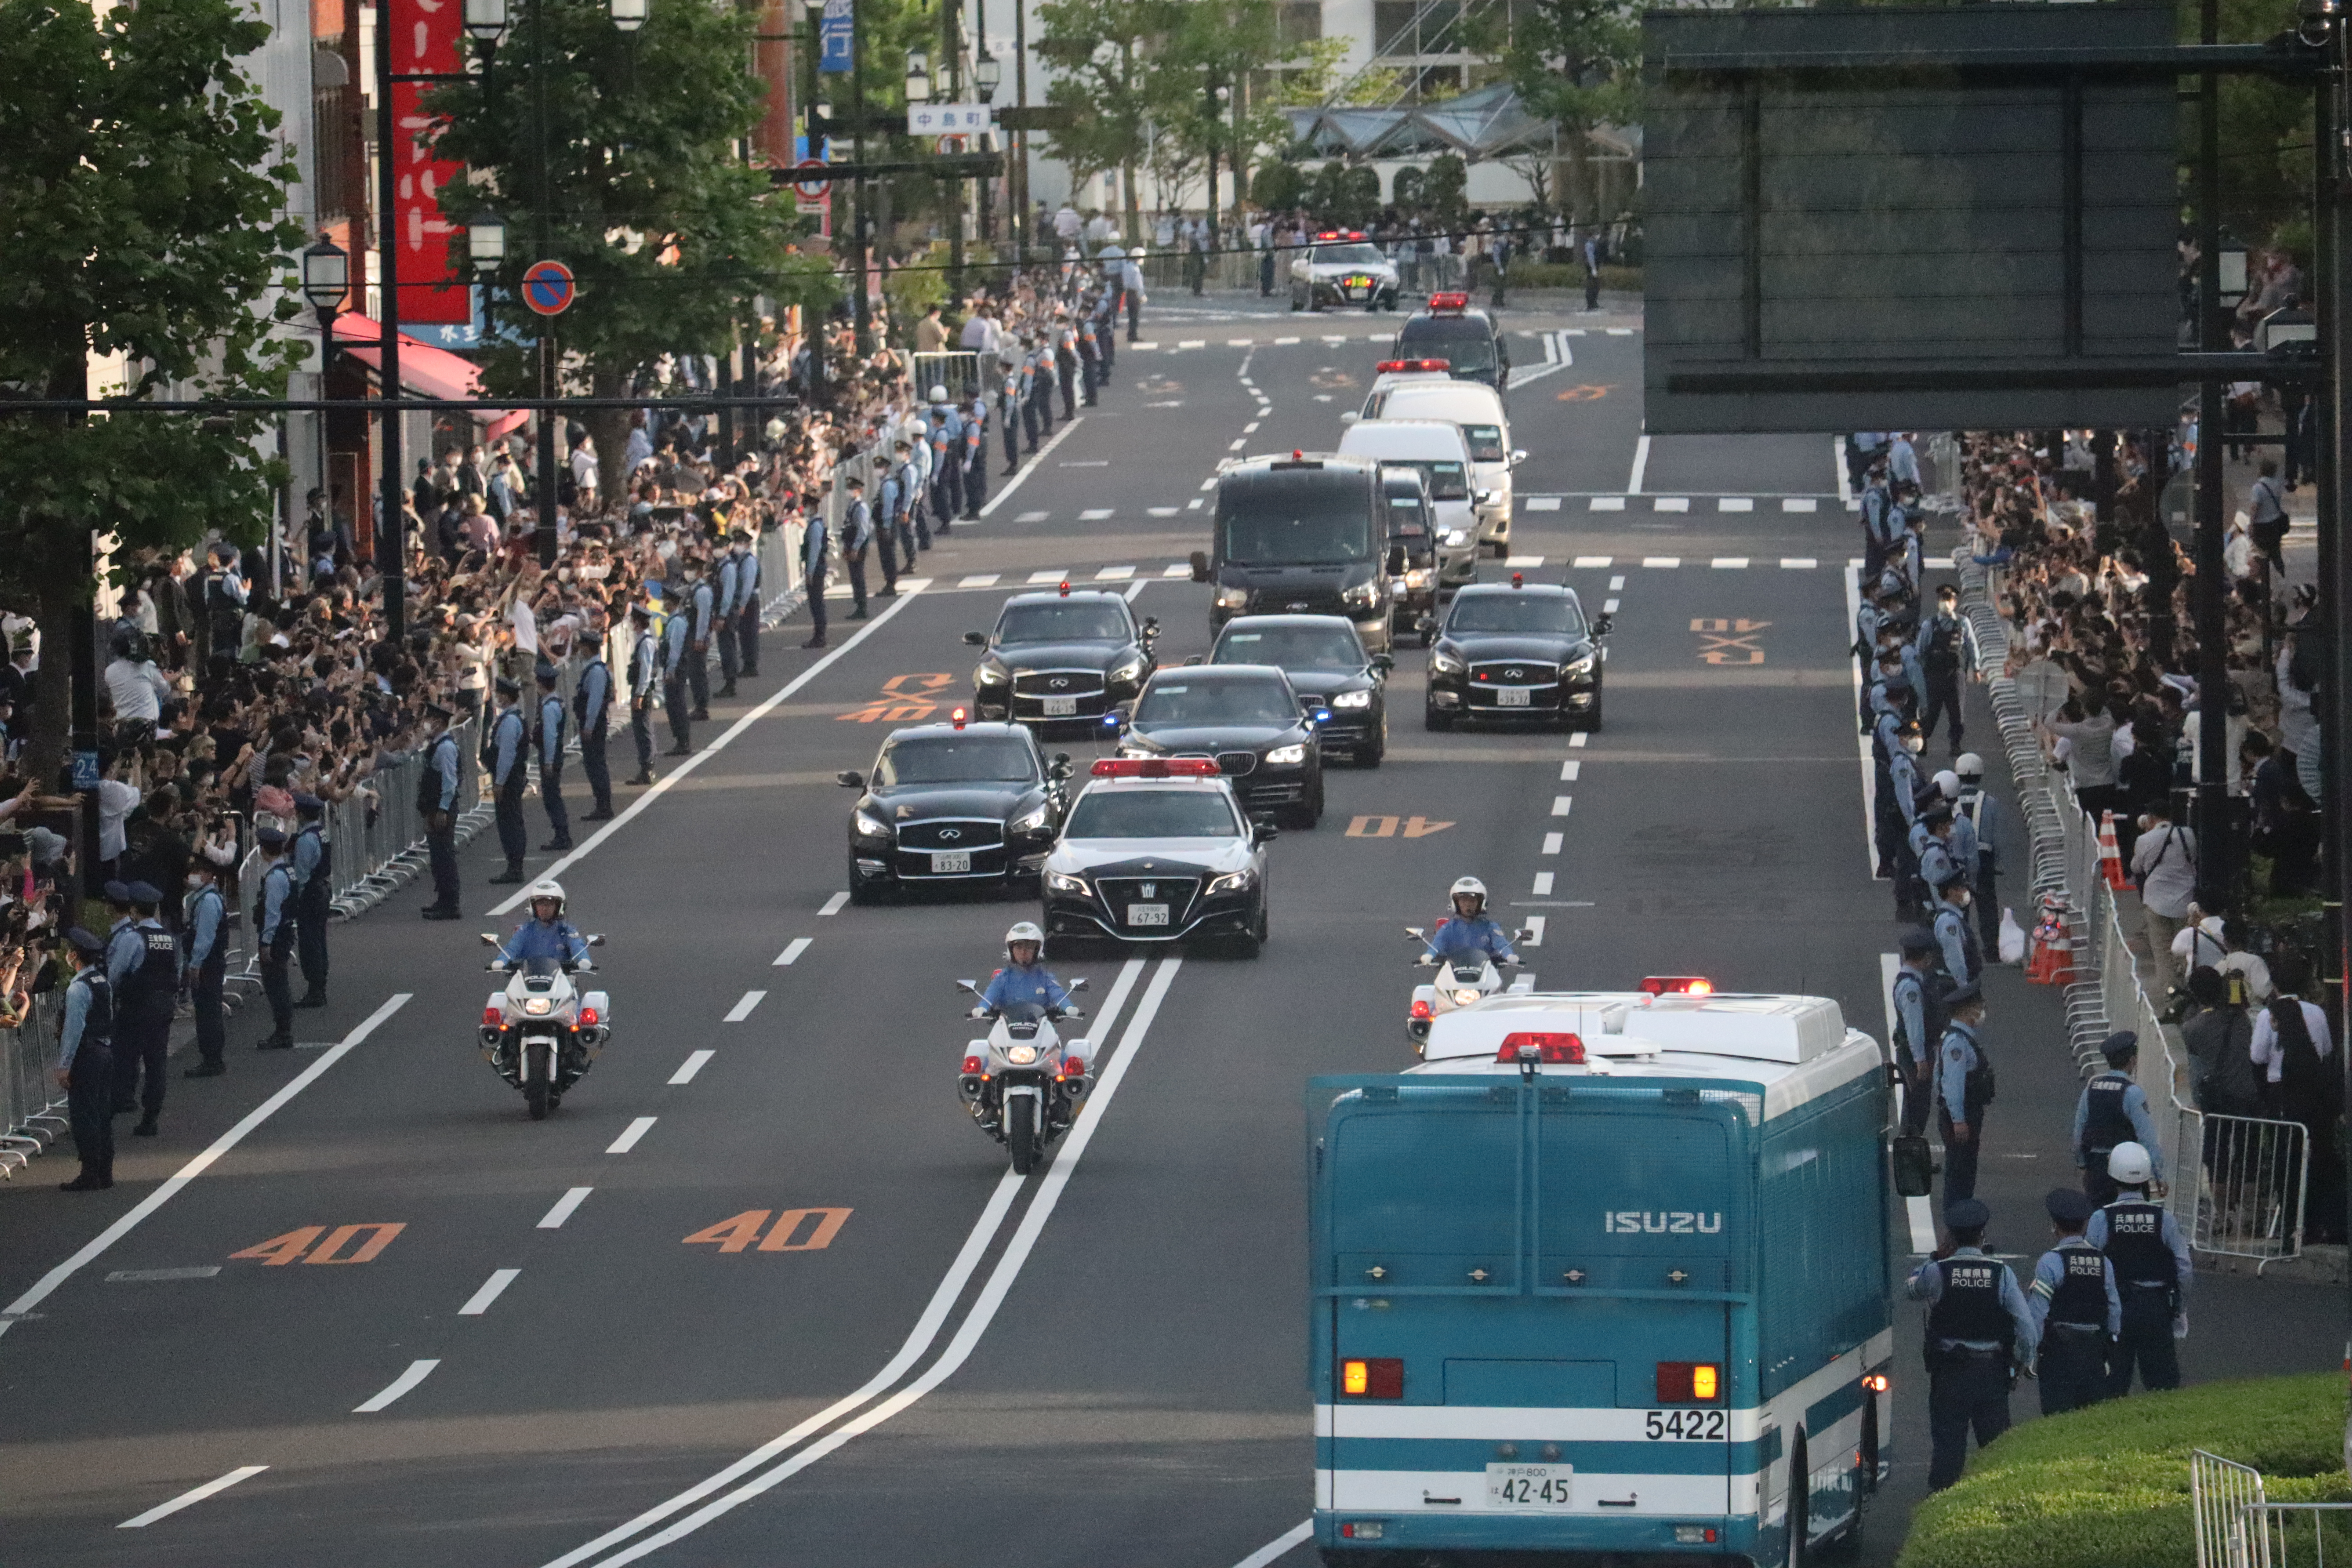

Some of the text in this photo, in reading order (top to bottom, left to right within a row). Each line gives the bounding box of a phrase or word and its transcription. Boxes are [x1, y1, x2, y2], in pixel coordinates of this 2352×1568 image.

[940, 860, 968, 871] 83-20
[1137, 913, 1166, 924] 67-92
[681, 1207, 854, 1252] 40
[1606, 1211, 1721, 1233] ISUZU
[2115, 1225, 2154, 1233] POLICE
[227, 1222, 407, 1265] 40
[2070, 1267, 2101, 1276] POLICE
[1952, 1279, 1991, 1287] POLICE
[1646, 1410, 1724, 1440] 5422
[1503, 1479, 1568, 1503] 42-45
